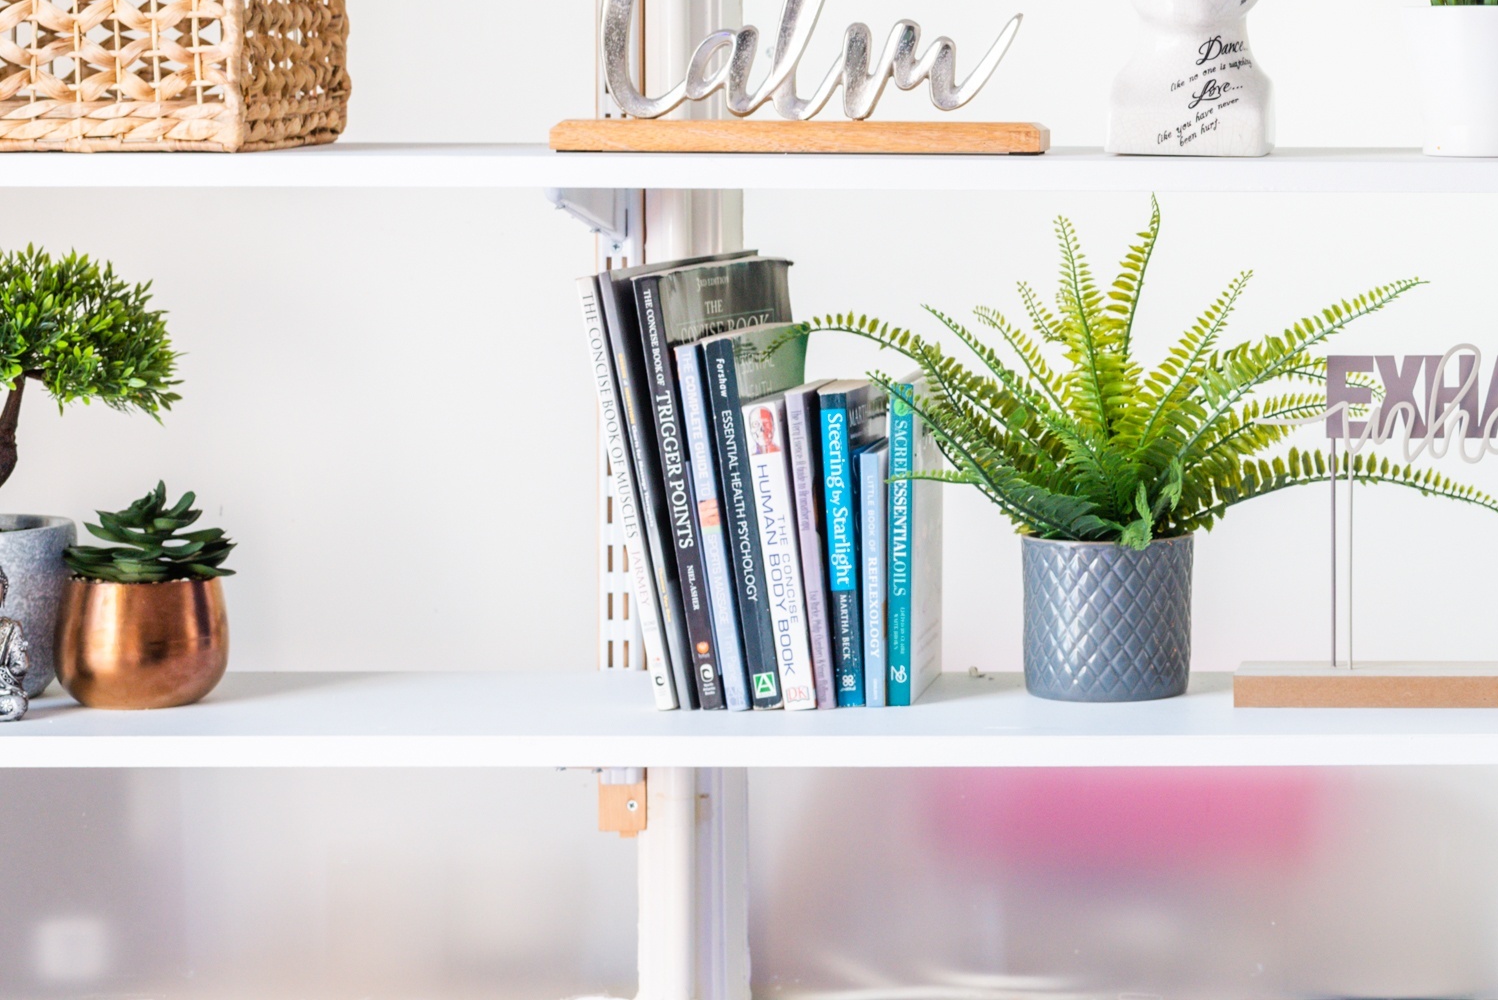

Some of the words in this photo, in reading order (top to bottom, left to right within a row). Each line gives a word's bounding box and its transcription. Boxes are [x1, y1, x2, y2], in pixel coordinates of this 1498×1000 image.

[1170, 79, 1185, 92] like
[1189, 73, 1199, 82] no
[1202, 66, 1217, 77] one
[1219, 62, 1226, 71] is
[1157, 130, 1172, 145] like
[1176, 120, 1192, 138] you
[1195, 107, 1214, 123] have
[1217, 97, 1239, 110] never
[1179, 131, 1198, 147] been
[581, 291, 598, 323] THE
[641, 288, 653, 308] THE
[704, 299, 723, 316] THE
[644, 308, 659, 347] CONCISE
[587, 326, 611, 396] CONCISE
[650, 347, 663, 372] BOOK
[654, 372, 665, 387] OF
[680, 350, 694, 374] THE
[714, 357, 730, 398] Forshaw
[601, 399, 620, 444] BOOK
[683, 374, 703, 440] COMPLETE
[653, 389, 684, 477] TRIGGER
[720, 409, 739, 470] ESSENTIAL
[820, 412, 848, 490] Steering
[609, 445, 625, 467] OF
[692, 441, 709, 479] GUIDE
[614, 470, 638, 539] MUSCLES
[698, 480, 711, 497] TO
[729, 471, 746, 518] HEALTH
[756, 463, 777, 546] HUMAN
[828, 489, 843, 505] by
[866, 475, 875, 505] LITTLE
[667, 478, 695, 550] POINTS
[776, 514, 788, 546] THE
[866, 509, 875, 536] BOOK
[706, 533, 722, 574] SPORTS
[736, 520, 758, 602] PSYCHOLOGY
[826, 506, 853, 585] Starlight
[867, 539, 876, 552] OF
[685, 564, 701, 611] NIEL-ASHER
[768, 552, 787, 612] BODY
[781, 552, 798, 624] CONCISE
[892, 560, 906, 596] OILS
[712, 575, 729, 625] MASSAGE
[838, 593, 850, 634] MARTHA
[867, 556, 880, 658] REFLEXOLOGY
[777, 618, 795, 676] BOOK
[840, 636, 851, 660] BECK
